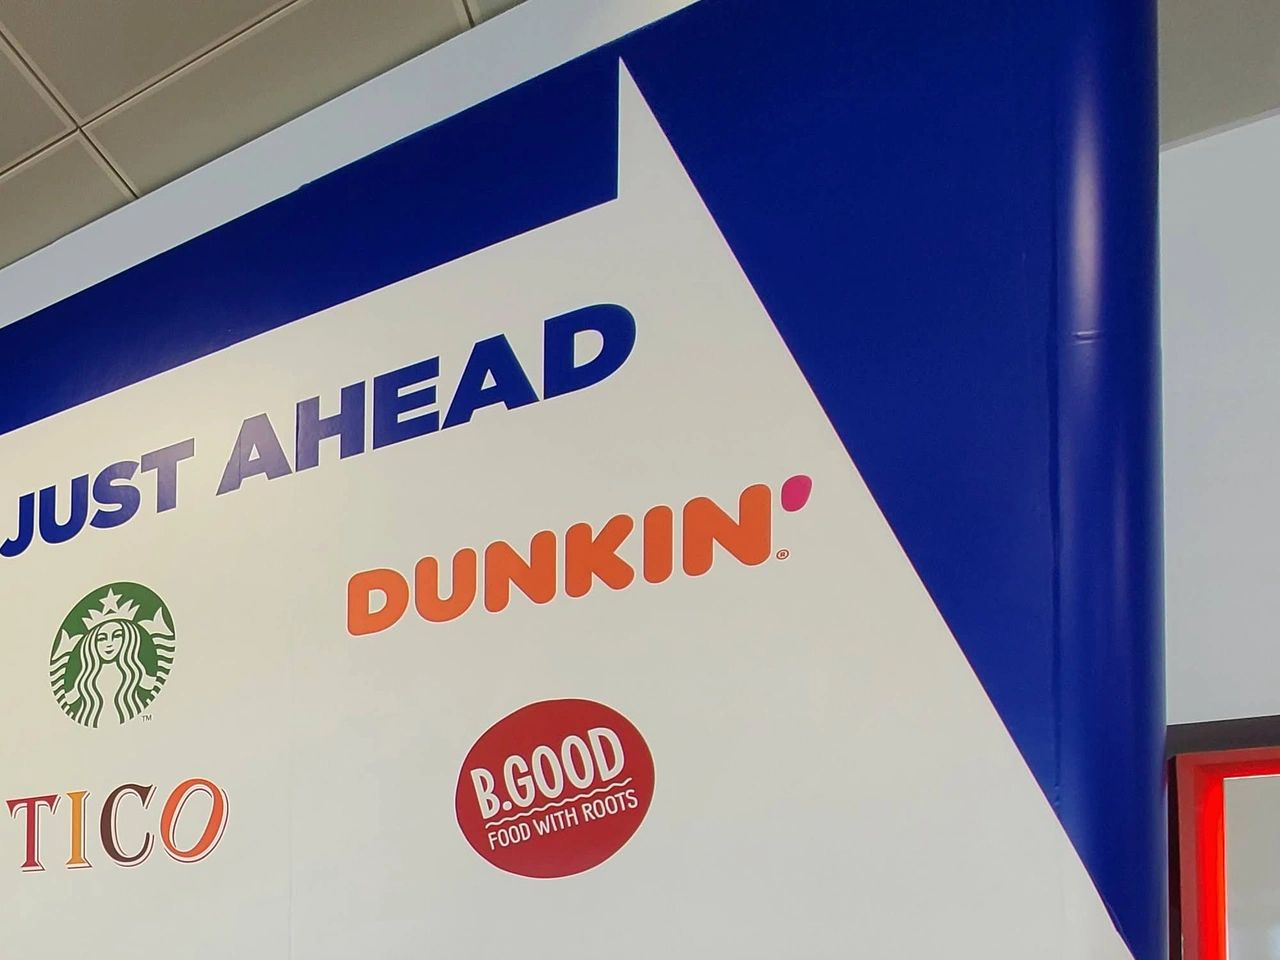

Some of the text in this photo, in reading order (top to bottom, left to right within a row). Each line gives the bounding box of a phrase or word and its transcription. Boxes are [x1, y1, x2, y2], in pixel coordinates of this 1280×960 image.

[216, 303, 637, 497] AHEAD
[347, 475, 812, 637] DUNKIN'
[471, 727, 625, 820] B.GOOD
[488, 789, 639, 851] FOOD WITH ROOTS
[6, 778, 230, 872] TICO
